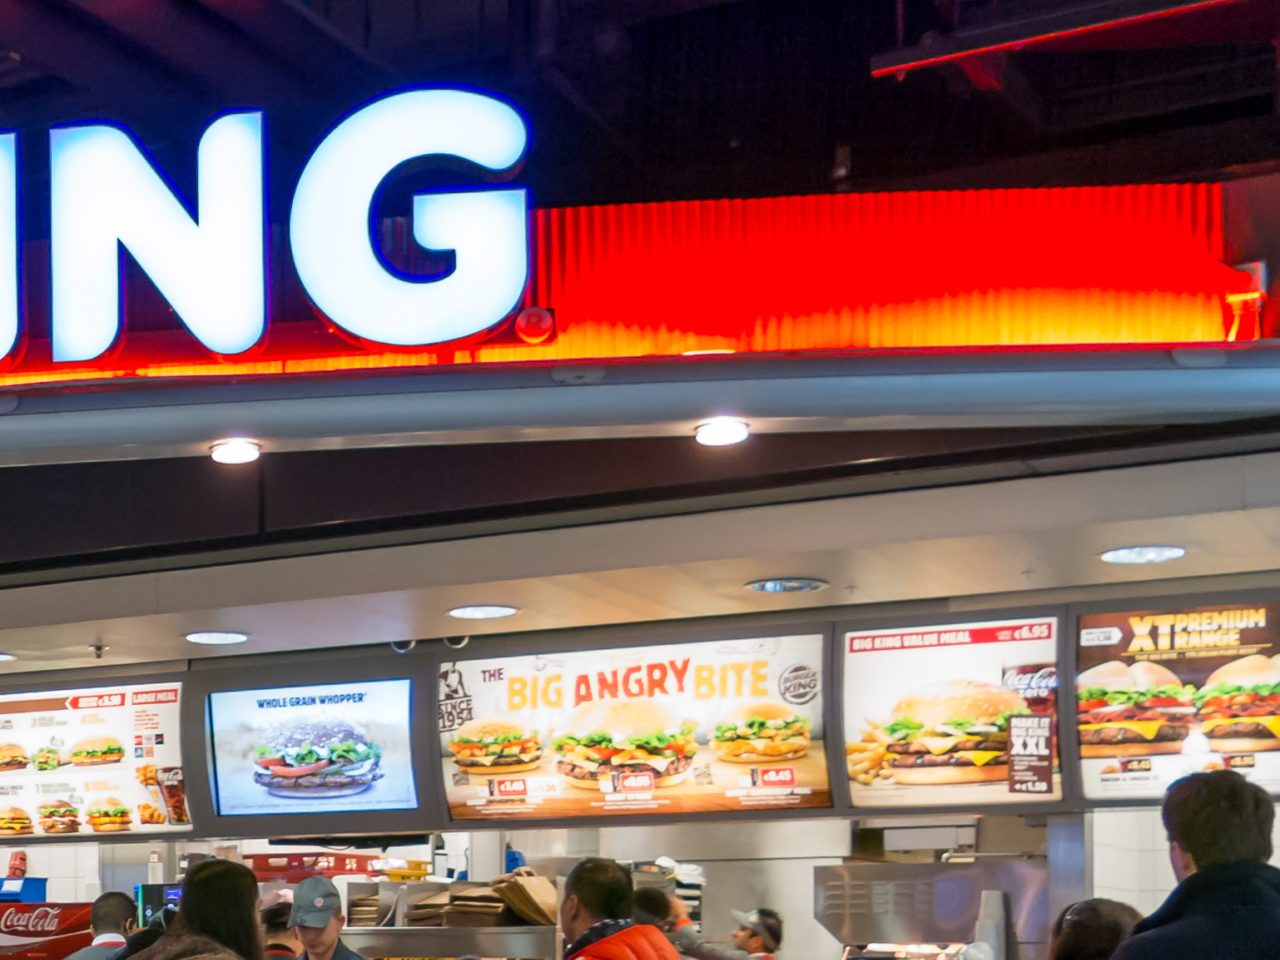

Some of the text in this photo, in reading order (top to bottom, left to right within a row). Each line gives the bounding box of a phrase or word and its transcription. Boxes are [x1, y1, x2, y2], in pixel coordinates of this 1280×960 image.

[1174, 608, 1267, 632] PREMIUM
[852, 631, 971, 650] BIG KING VALUE MEAL
[1013, 625, 1049, 640] €6.95
[1174, 629, 1242, 650] RANGE
[481, 657, 770, 712] THE BIG ANGRY BITE
[782, 678, 818, 696] KING
[257, 692, 365, 709] WHOLE GRAIN WHOPPER
[438, 699, 473, 714] SINCE
[438, 709, 474, 729] 1954
[1010, 736, 1051, 755] XXL
